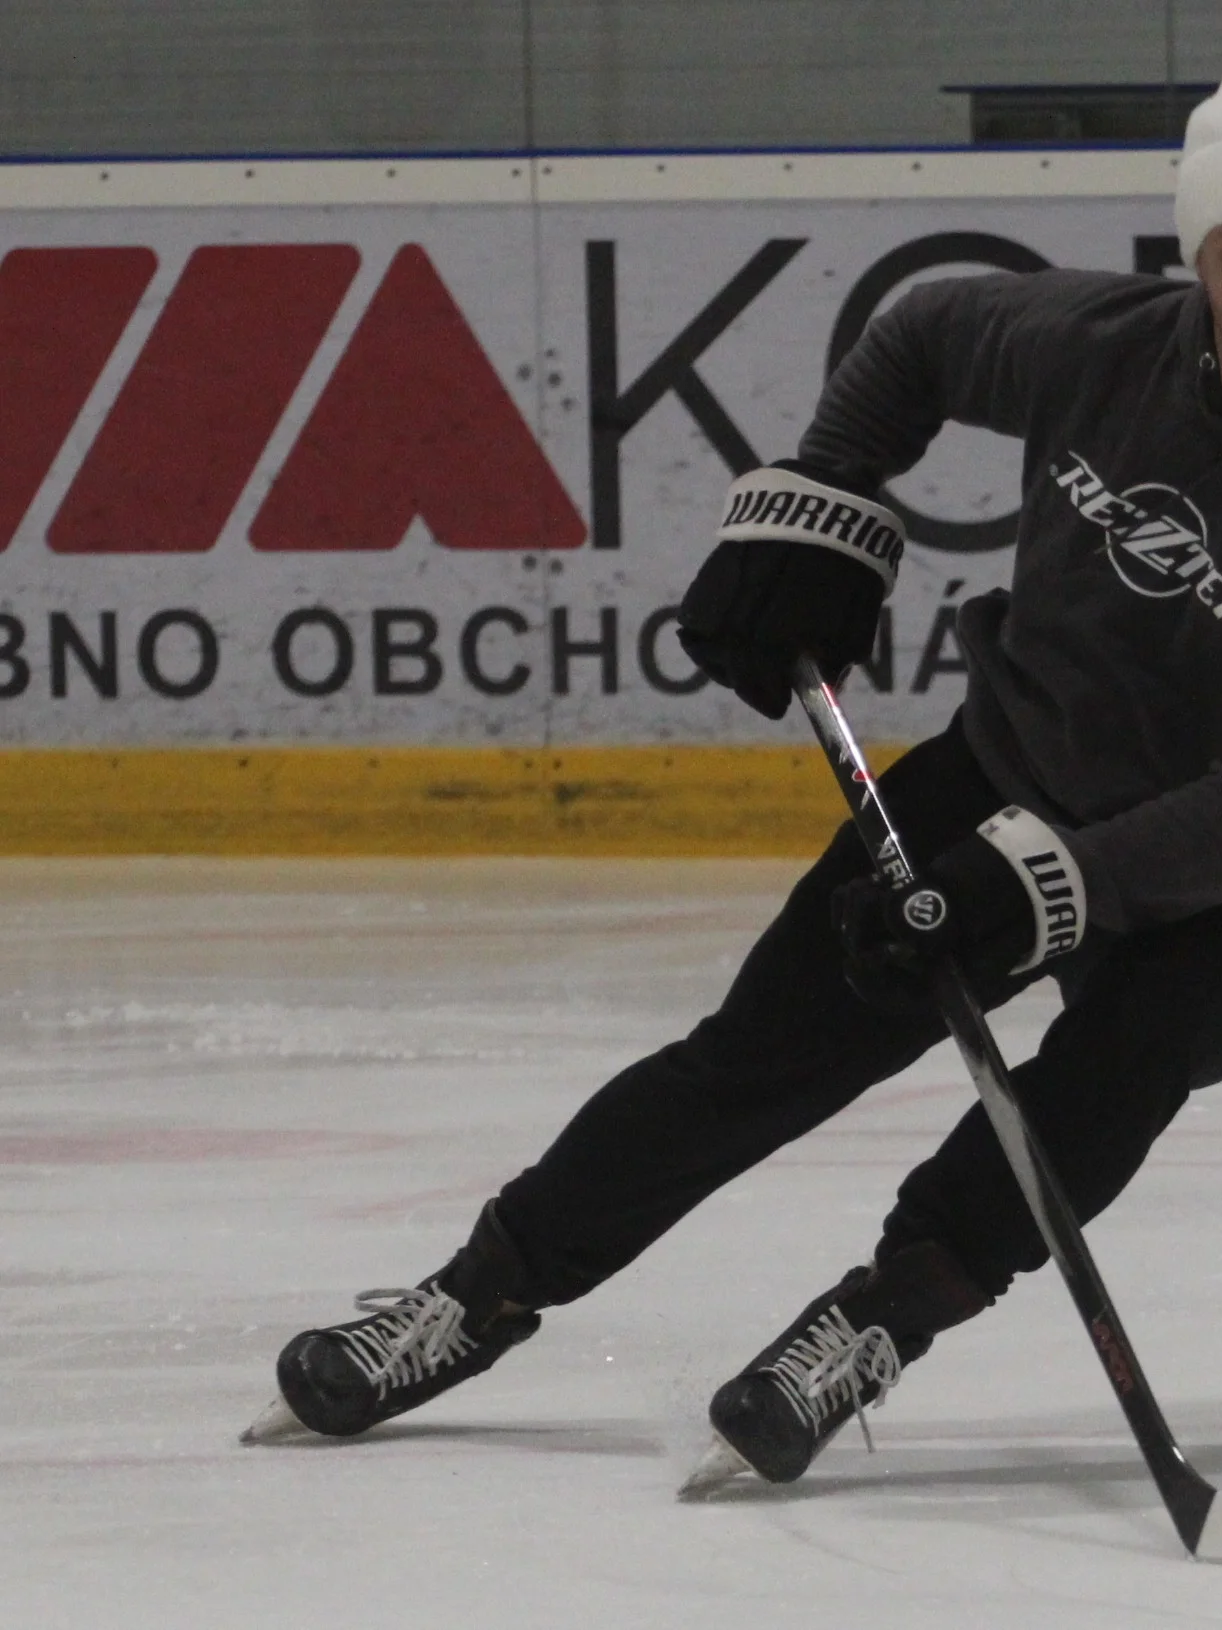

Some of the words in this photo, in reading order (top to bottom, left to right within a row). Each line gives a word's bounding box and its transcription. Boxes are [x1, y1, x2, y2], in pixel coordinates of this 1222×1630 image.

[722, 490, 905, 577] WARRIOR
[271, 577, 970, 697] OBCHOÁ
[1022, 851, 1077, 959] WAR
